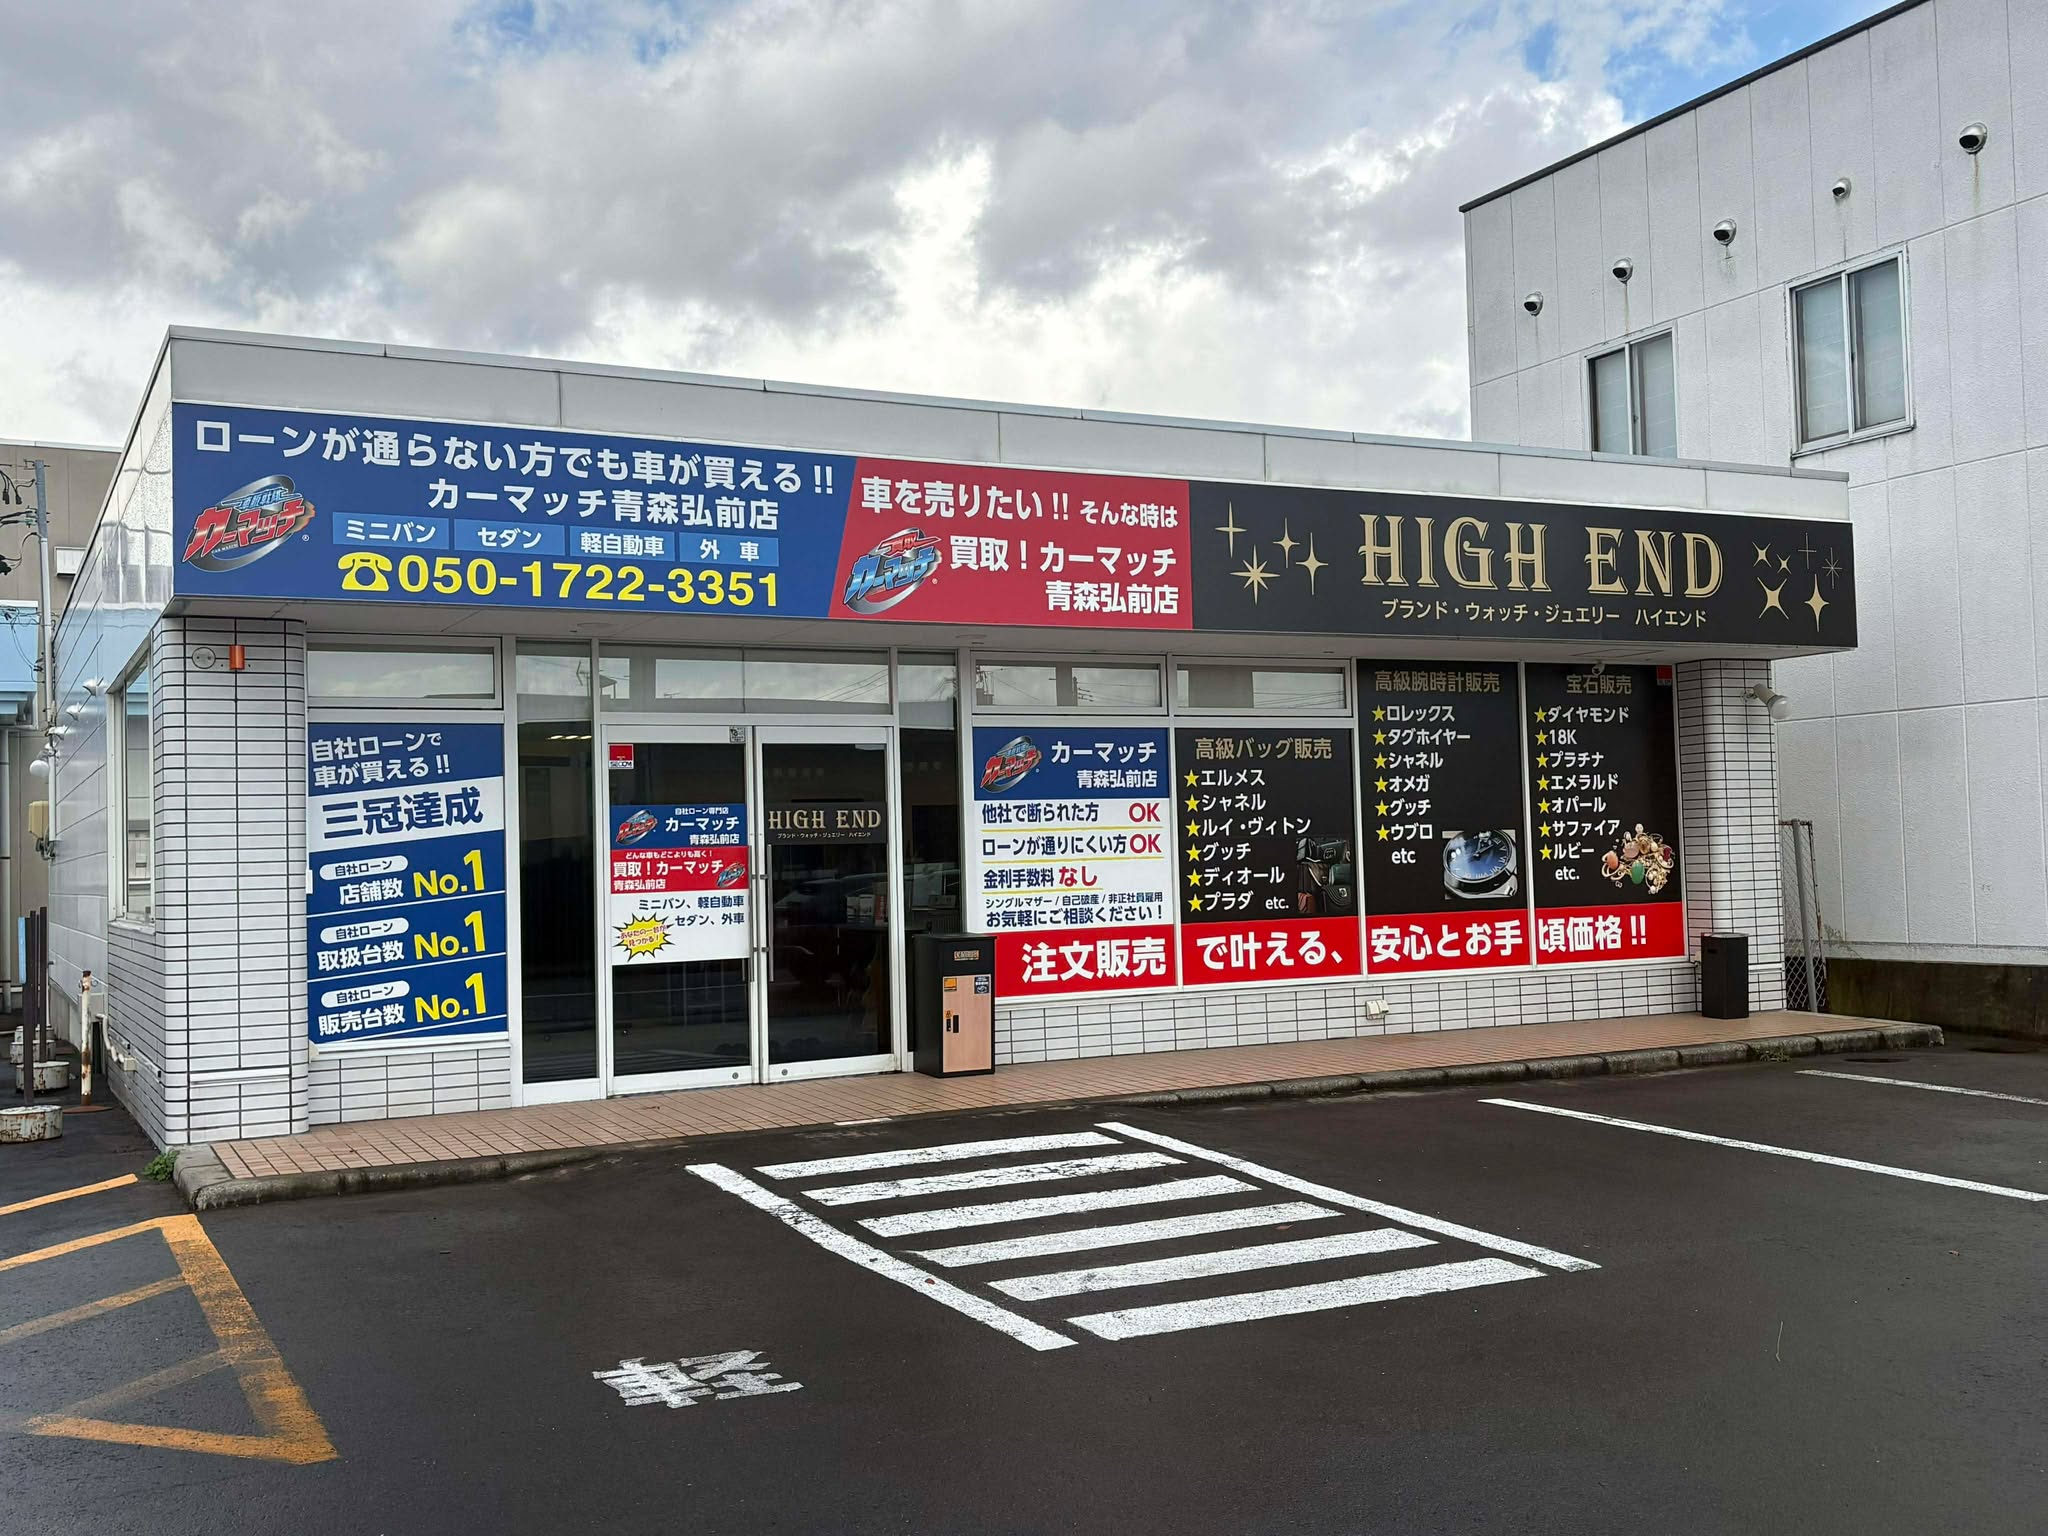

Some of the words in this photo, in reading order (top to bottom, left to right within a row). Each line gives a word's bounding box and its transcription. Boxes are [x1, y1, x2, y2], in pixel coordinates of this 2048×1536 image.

[428, 478, 779, 531] カーマッチ青森弘前店
[1080, 501, 1178, 529] そんな時は
[346, 520, 436, 544] ミニバン
[477, 526, 542, 548] セダン
[580, 532, 664, 557] 軽自動車
[1358, 514, 1553, 593] HIGH
[1584, 525, 1725, 599] END
[398, 560, 777, 607] 050-1722-3351
[1046, 580, 1179, 614] 青森弘前店
[1635, 608, 1707, 629] ハイエンド
[1374, 670, 1500, 694] 高級腕時計販売
[1566, 673, 1632, 695] 宝石販売
[1386, 705, 1455, 721] ロレックス
[1548, 706, 1629, 723] ダイヤモンド
[1387, 728, 1471, 745] タグホイヤー
[1549, 729, 1577, 745] 18K
[311, 732, 442, 763] 自社ローンで
[1051, 741, 1157, 764] カーマッチ
[1194, 737, 1333, 760] 高級バッグ販売
[1388, 752, 1443, 768] シャネル
[1550, 751, 1604, 768] プラチナ
[1076, 769, 1158, 789] 青森弘前店
[1200, 769, 1266, 787] エルメス
[1389, 774, 1430, 792] オメガ
[1551, 773, 1619, 791] エメラルド
[322, 786, 484, 840] 三冠達成
[982, 803, 1100, 824] 他社で断られた方
[1128, 802, 1160, 822] OK
[1201, 794, 1266, 812] シャネル
[1390, 798, 1431, 816] グッチ
[1551, 797, 1606, 813] オパール
[665, 817, 740, 832] カーマッチ
[768, 809, 826, 829] HIGH
[836, 809, 882, 829] END
[1202, 816, 1311, 836] ルイ・ヴィトン
[1552, 819, 1620, 836] サファイア
[689, 834, 740, 845] 青森弘前店
[1390, 823, 1433, 840] ウブロ
[982, 834, 1127, 856] ローンが通りにくい方
[1129, 833, 1162, 854] OK
[1202, 842, 1251, 862] グッチ
[1553, 843, 1594, 859] ルビー
[1391, 848, 1416, 864] etc
[334, 860, 393, 877] 自社ローン
[339, 878, 404, 905] 店舗数
[413, 849, 485, 898] No.1
[983, 868, 1054, 888] 金利手数料
[1058, 866, 1098, 887] なし
[1203, 866, 1285, 886] ディオール
[1555, 866, 1580, 881] etc.
[613, 879, 666, 891] 青森弘前店
[1204, 890, 1253, 911] プラダ
[335, 921, 394, 940] 自社ローン
[317, 940, 405, 972] 取扱台数
[414, 910, 486, 960] No.1
[1021, 937, 1167, 984] 注文販売
[1371, 919, 1523, 963] 安心とお手
[318, 1003, 406, 1036] 販売台数
[414, 972, 487, 1023] No.1
[336, 985, 394, 1004] 自社ローン
